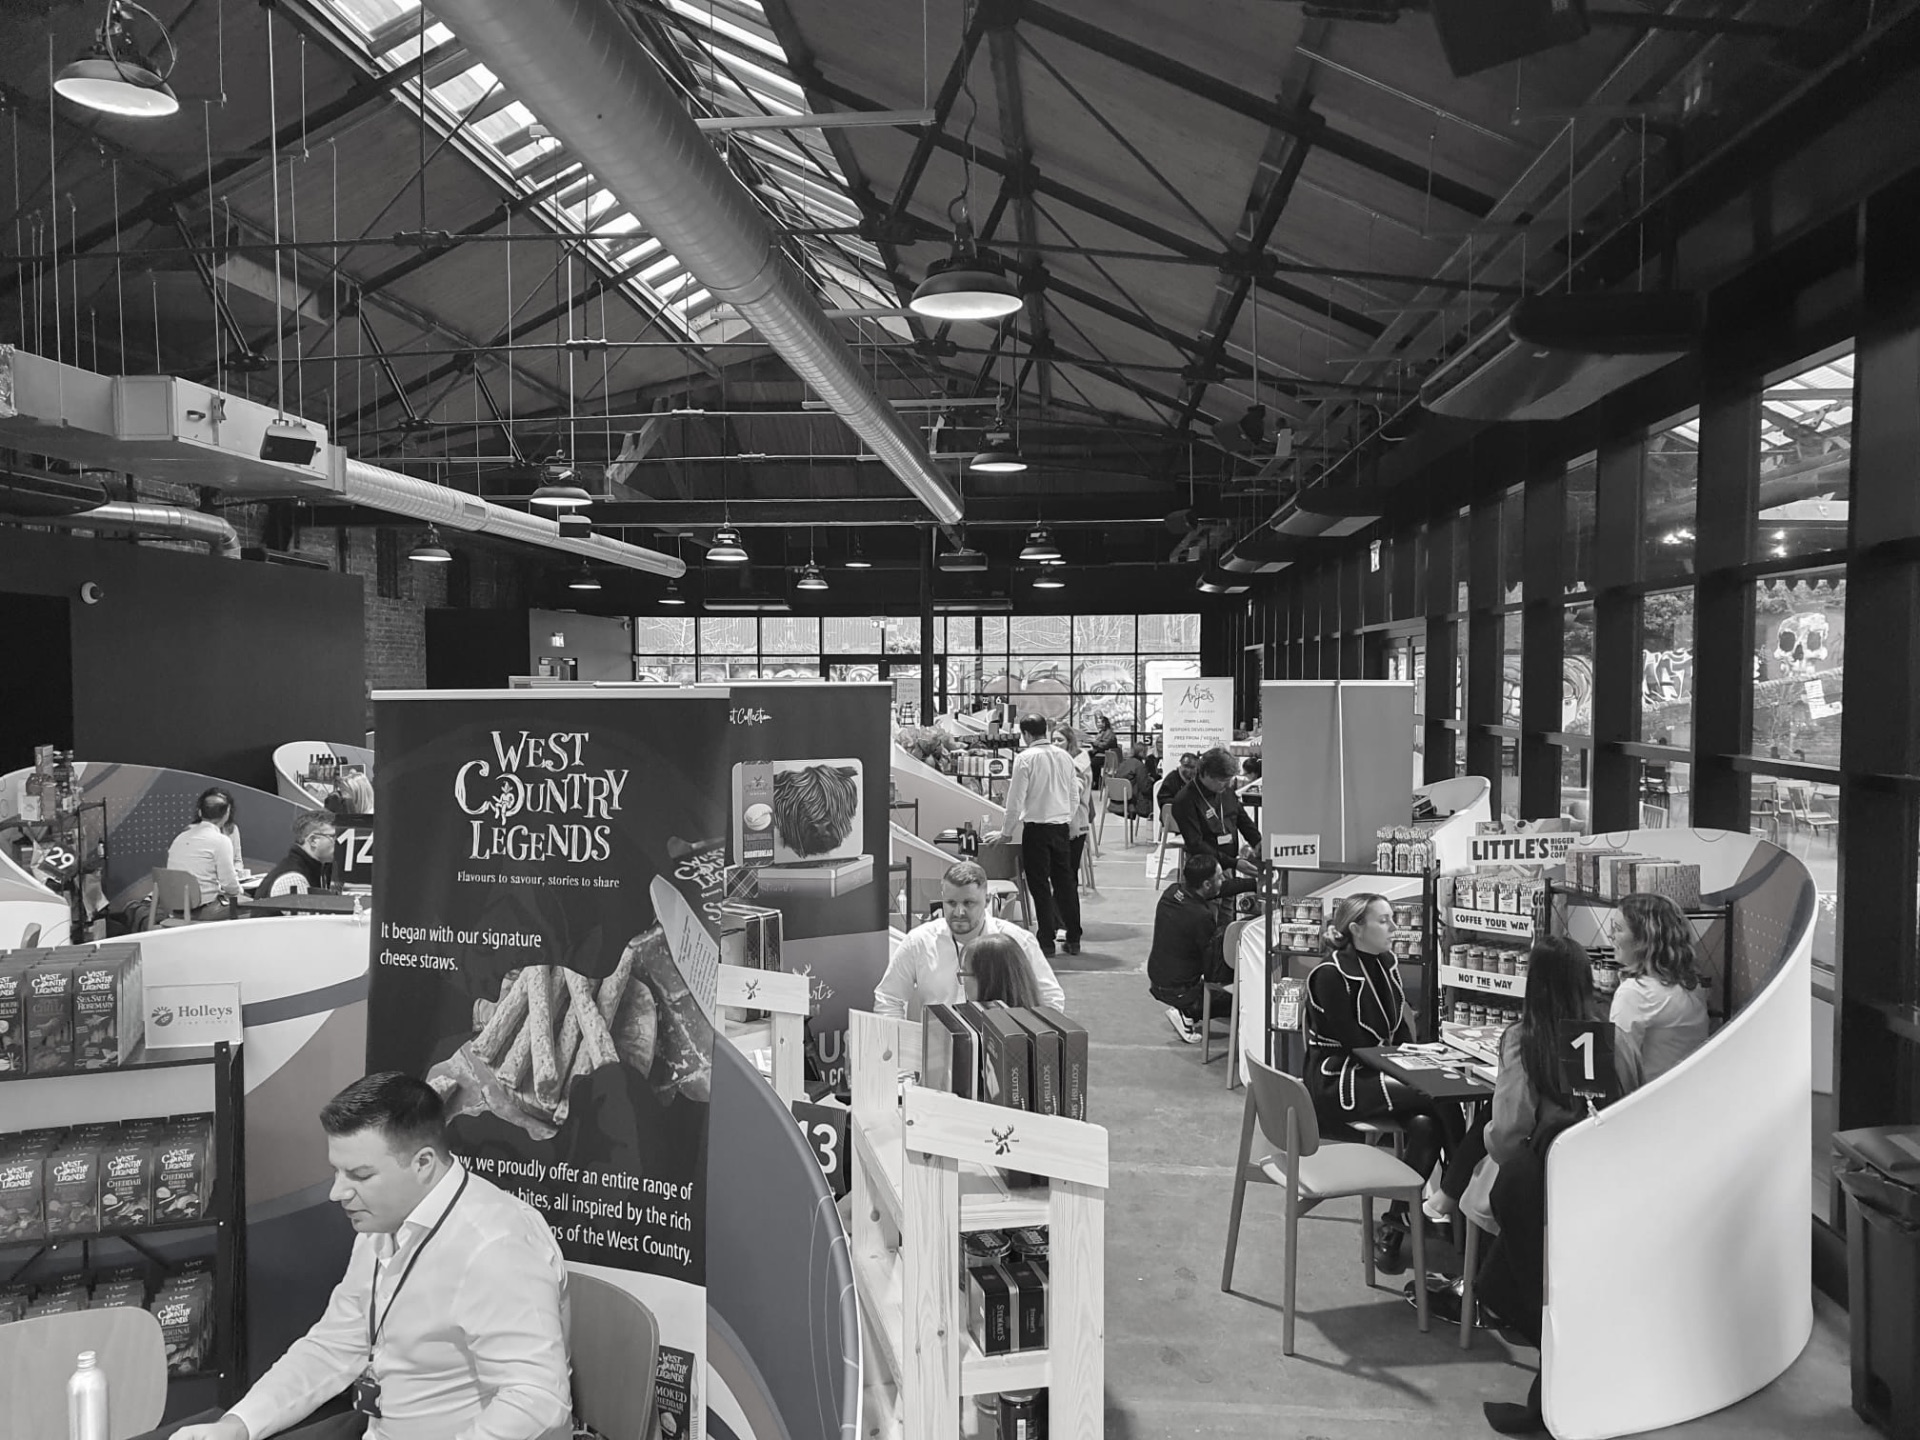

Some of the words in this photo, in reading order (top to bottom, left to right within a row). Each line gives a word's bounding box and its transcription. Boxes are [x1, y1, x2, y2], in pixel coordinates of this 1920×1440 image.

[995, 696, 1002, 705] 6
[737, 707, 773, 726] Collection
[490, 730, 590, 773] WEST
[1144, 735, 1152, 745] 5
[454, 759, 630, 825] COUNTRY
[468, 819, 611, 862] LEGENDS
[959, 834, 975, 851] 11
[1472, 837, 1549, 861] LITTLE'S
[1550, 837, 1575, 845] BIGGER
[45, 846, 75, 869] 29
[457, 870, 496, 883] Flavours
[498, 873, 508, 884] to
[510, 875, 545, 887] savour,
[547, 874, 580, 887] stories
[581, 876, 591, 887] to
[593, 875, 620, 889] share
[1455, 914, 1482, 926] COFFEE
[1485, 917, 1507, 928] YOUR
[1510, 920, 1529, 931] WAY
[381, 921, 389, 939] It
[392, 921, 427, 944] began
[429, 925, 454, 943] with
[457, 929, 480, 945] our
[482, 928, 542, 950] signature
[379, 948, 418, 968] cheese
[419, 953, 459, 971] straws.
[1458, 973, 1474, 984] NOT
[1476, 976, 1491, 987] THE
[1494, 978, 1513, 990] WAY
[178, 1004, 233, 1020] Holleys
[1570, 1031, 1595, 1080] 1
[799, 1120, 838, 1174] 3
[476, 1156, 494, 1172] we
[497, 1158, 546, 1182] proudly
[549, 1162, 580, 1184] offer
[582, 1170, 598, 1186] an
[601, 1171, 639, 1192] entire
[643, 1178, 678, 1201] range
[680, 1182, 694, 1201] of
[553, 1192, 569, 1211] all
[572, 1194, 623, 1220] inspired
[627, 1199, 643, 1227] by
[646, 1205, 667, 1227] the
[669, 1210, 692, 1232] rich
[566, 1223, 582, 1243] of
[583, 1226, 605, 1248] the
[607, 1229, 640, 1253] West
[642, 1234, 693, 1267] Country.
[655, 1385, 688, 1403] MOKED
